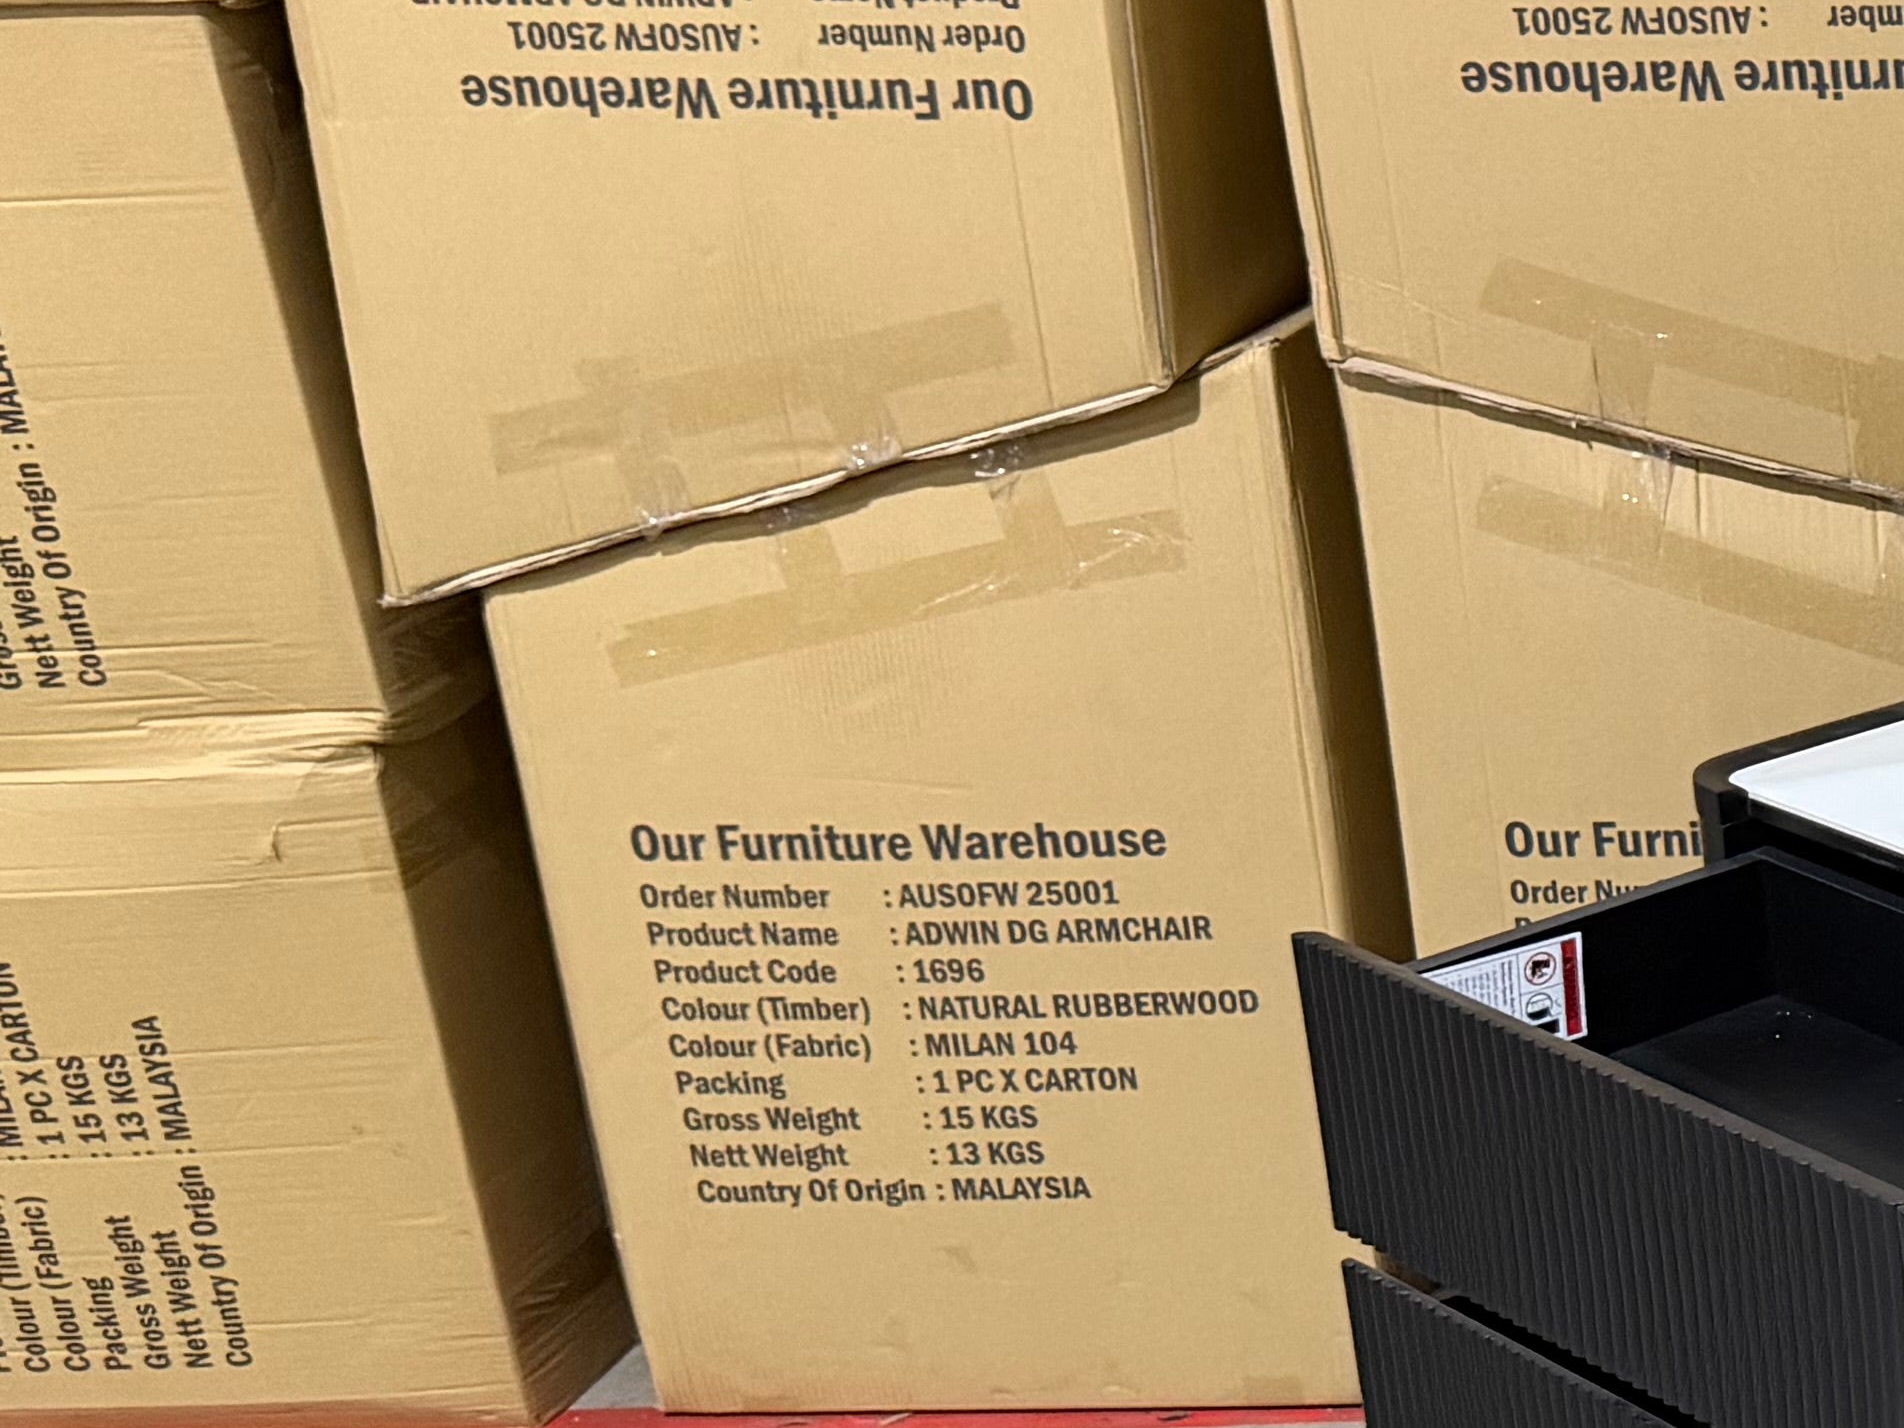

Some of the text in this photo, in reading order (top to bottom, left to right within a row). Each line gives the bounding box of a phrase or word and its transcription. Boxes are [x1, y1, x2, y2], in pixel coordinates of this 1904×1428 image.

[1512, 7, 1612, 35] 25001
[1621, 6, 1751, 35] AUSOFW
[461, 75, 1032, 120] Our Furniture Warehouse
[1461, 60, 1724, 102] Warehouse
[14, 463, 60, 544] Origin
[36, 550, 72, 579] Of
[52, 586, 110, 688] Country
[32, 633, 69, 688] Nett
[631, 823, 1166, 861] Our Furniture Warehouse
[1505, 821, 1704, 858] Our Furni
[1510, 880, 1588, 904] Order
[647, 922, 756, 946] Product
[760, 922, 838, 946] Name
[906, 921, 1000, 945] ADWIN
[1007, 920, 1048, 944] DG
[1057, 916, 1212, 943] ARMCHAIR
[662, 997, 749, 1021] Colour
[757, 997, 870, 1025] (Timber)
[918, 995, 1047, 1020] NATURAL
[1053, 990, 1258, 1018] RUBBERWOOD
[16, 1069, 47, 1085] X
[99, 1054, 138, 1104] KGS
[131, 1016, 192, 1140] MALAYSIA
[24, 1091, 59, 1123] PC
[36, 1131, 65, 1145] 1
[115, 1112, 149, 1141] 13
[177, 1166, 217, 1236] Origin
[698, 1180, 801, 1207] Country
[809, 1179, 837, 1202] Of
[845, 1179, 925, 1207] Origin
[952, 1176, 1091, 1200] MALAYSIA
[150, 1230, 197, 1313] Weight
[193, 1243, 226, 1269] Of
[82, 1276, 132, 1370] Packing
[210, 1275, 253, 1367] Country
[175, 1318, 213, 1368] Nett
